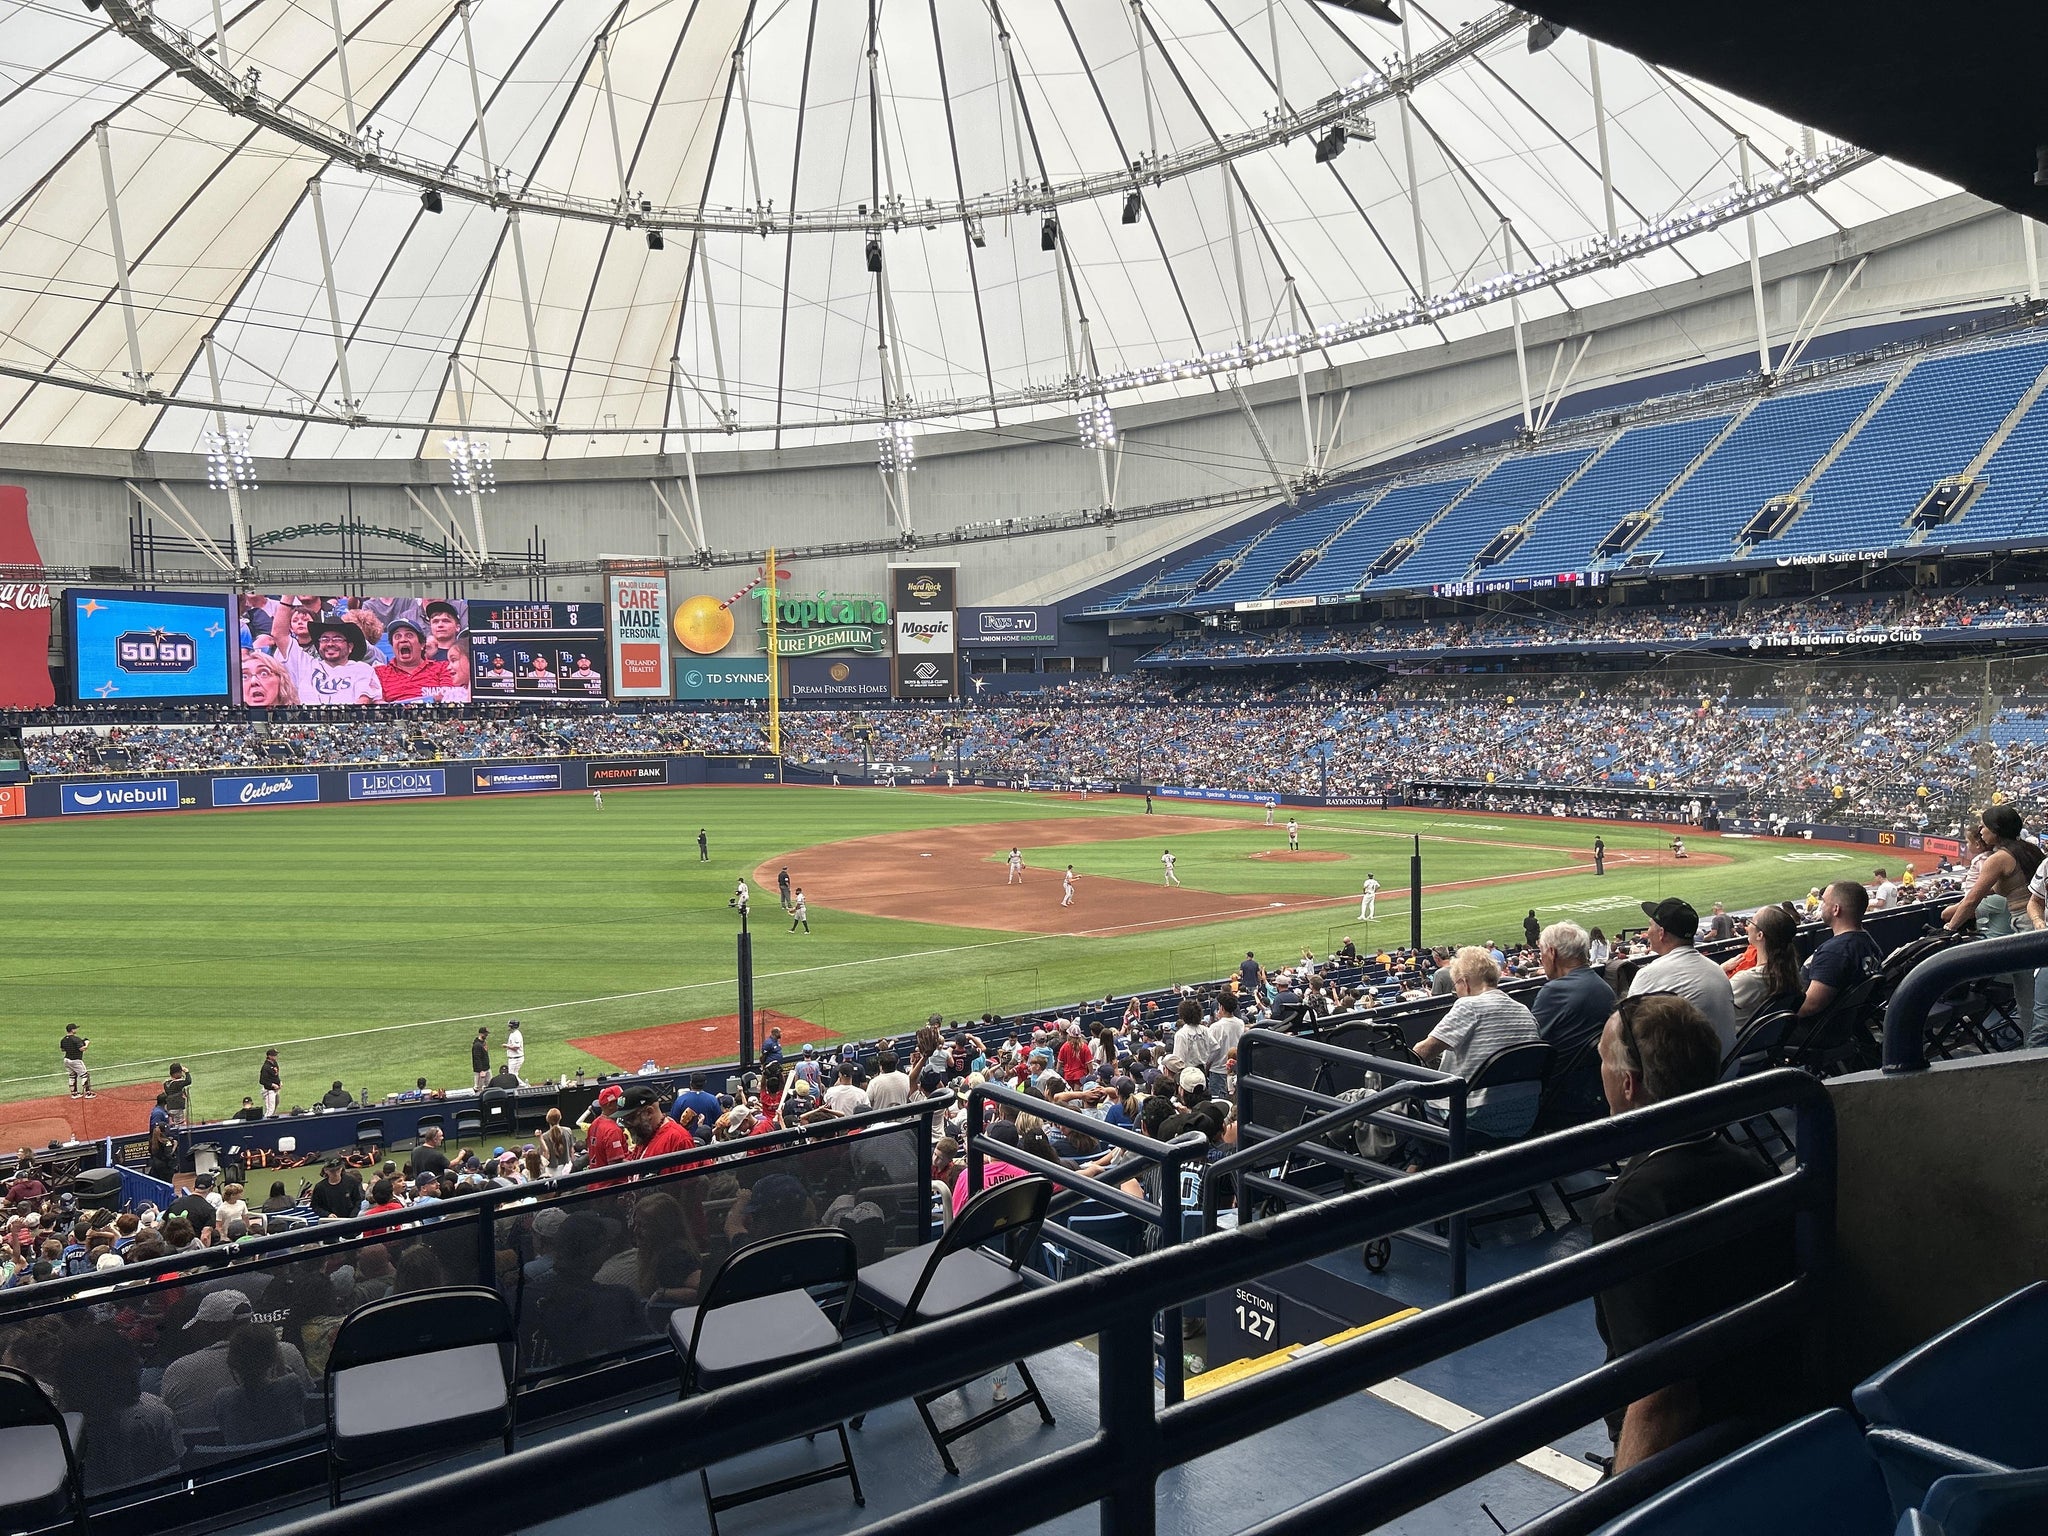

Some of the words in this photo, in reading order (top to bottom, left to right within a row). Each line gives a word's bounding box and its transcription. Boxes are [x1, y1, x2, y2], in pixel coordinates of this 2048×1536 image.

[1793, 554, 1826, 566] Webull
[1828, 552, 1856, 562] Suite
[1858, 549, 1888, 560] Level
[618, 581, 638, 589] MAJOR
[638, 582, 659, 590] LEAGUE
[908, 582, 925, 591] Hard
[925, 582, 942, 592] Rock
[0, 584, 51, 610] a-Cola
[618, 589, 659, 609] CARE
[567, 604, 579, 612] BOT
[751, 587, 888, 629] Tropicana
[569, 612, 578, 626] 8
[620, 610, 660, 628] MADE
[1014, 619, 1031, 629] .TV
[901, 620, 949, 633] Mosaic
[620, 628, 661, 639] PERSONAL
[1766, 636, 1789, 647] The
[1791, 633, 1844, 646] Baldwin
[1846, 632, 1887, 645] Group
[1890, 631, 1922, 642] Club
[472, 636, 487, 645] DUE
[487, 636, 498, 644] UP
[769, 636, 806, 652] PURE
[808, 630, 872, 650] PREMIUM
[629, 665, 655, 673] HEALTH
[706, 674, 723, 684] TD
[725, 673, 773, 684] SYNNEX
[792, 685, 823, 695] DREAM
[824, 685, 857, 694] FINDERS
[858, 684, 888, 694] HOMES
[594, 768, 638, 779] AMERANT
[638, 768, 661, 778] BANK
[362, 774, 433, 790] LECOM
[106, 787, 168, 804] Webull
[240, 777, 294, 804] Culver's
[1183, 789, 1200, 797] Spectrum
[180, 797, 196, 805] 382
[222, 1243, 240, 1255] 13
[1236, 1288, 1275, 1314] SECTION
[1235, 1305, 1276, 1342] 127
